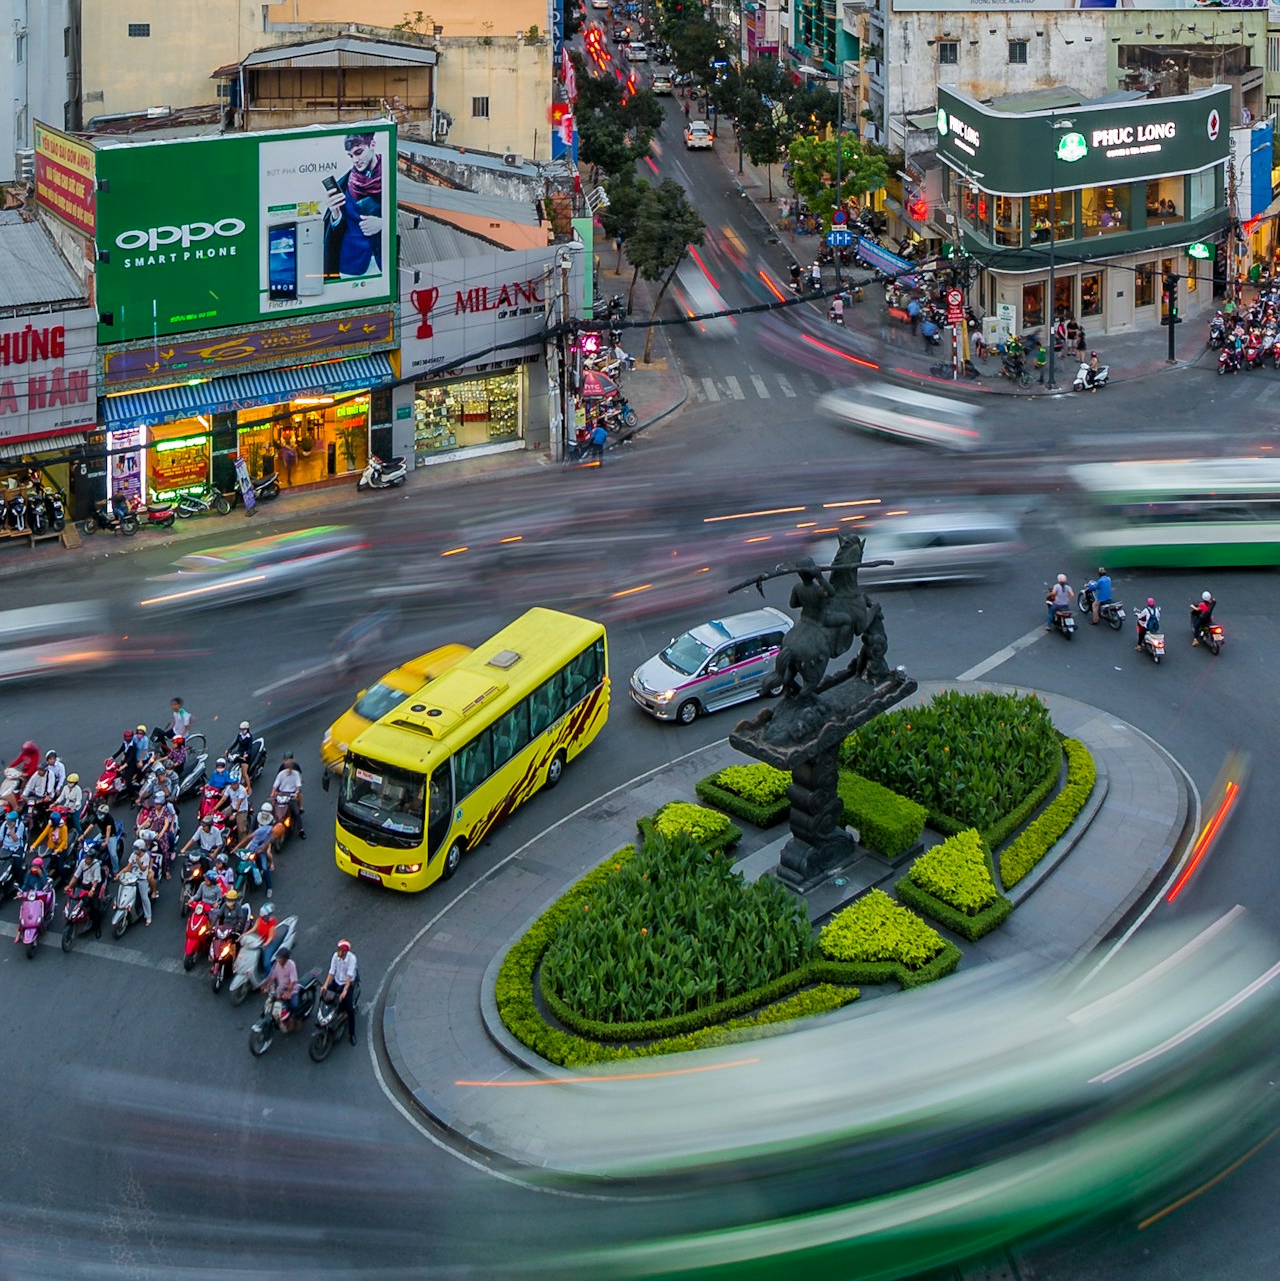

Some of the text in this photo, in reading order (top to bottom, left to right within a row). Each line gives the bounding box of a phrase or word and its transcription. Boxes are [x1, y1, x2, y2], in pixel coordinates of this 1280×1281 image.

[949, 115, 964, 137] PHUC
[964, 126, 980, 147] LONG
[1092, 122, 1176, 147] PHUC LONG
[298, 161, 317, 174] GIỚI
[318, 160, 338, 174] HẠN
[297, 201, 322, 217] 2K
[124, 246, 237, 268] SMART PHONE
[28, 366, 88, 411] HÂN
